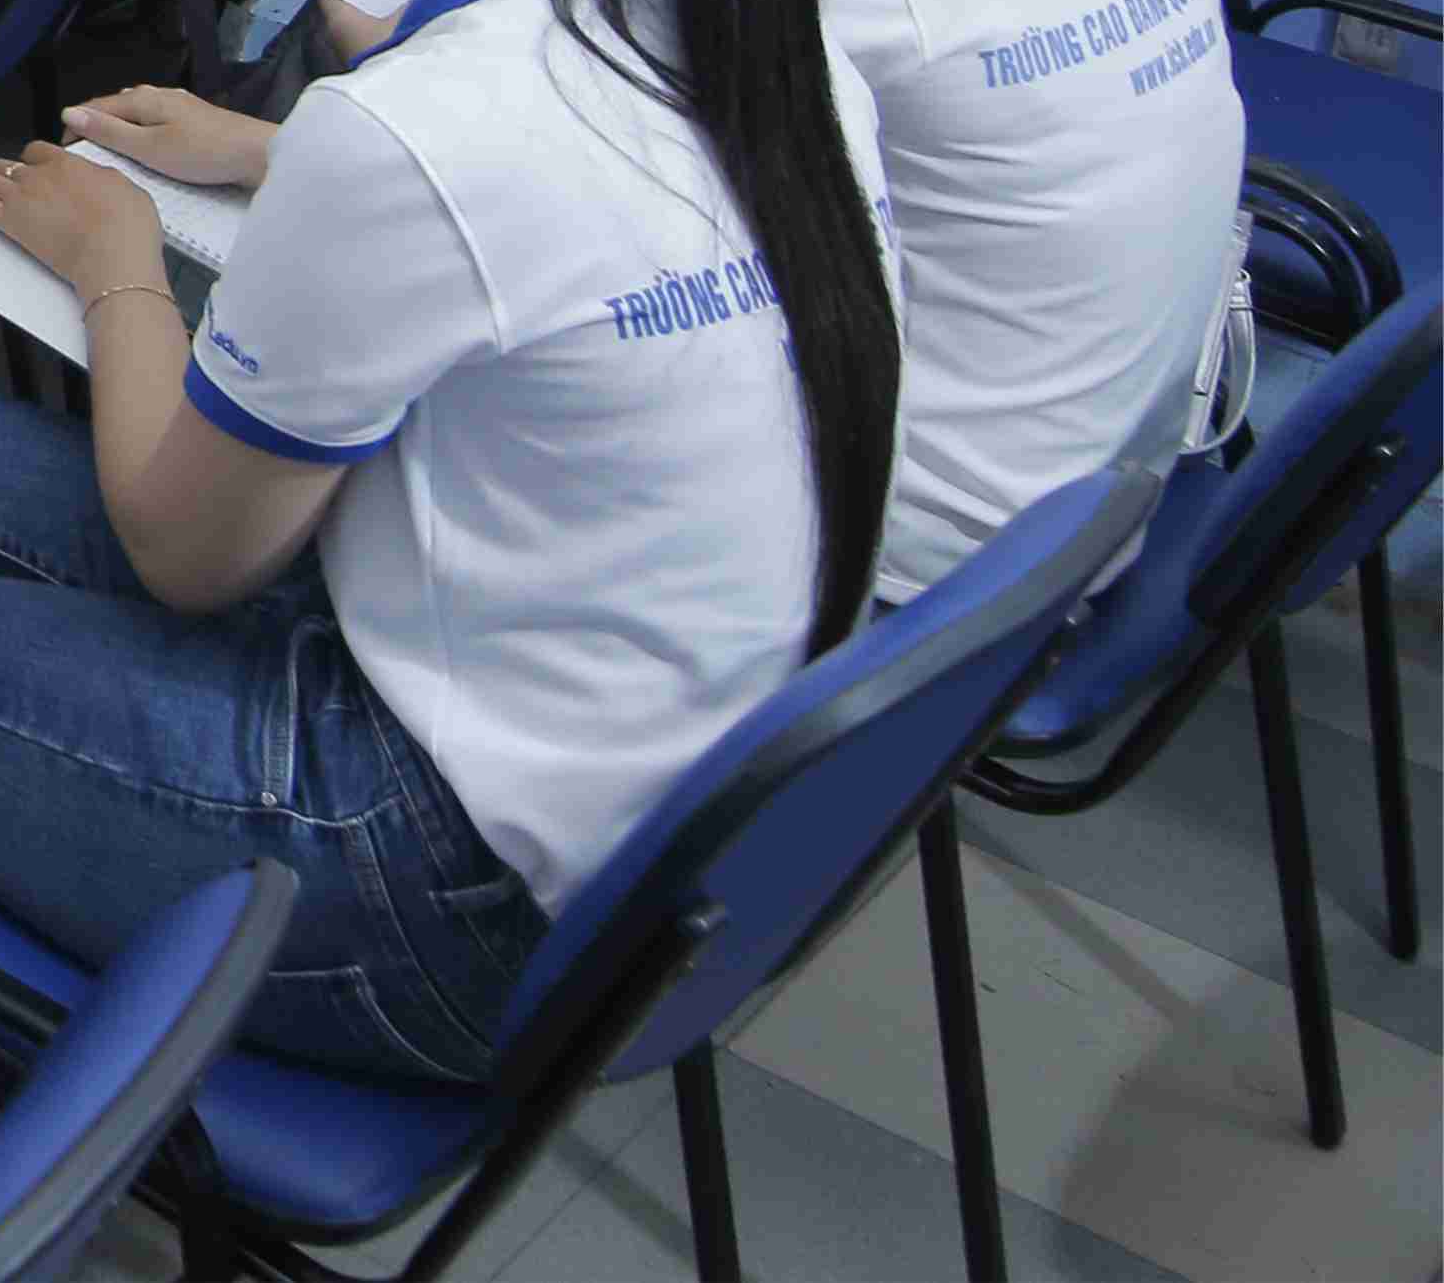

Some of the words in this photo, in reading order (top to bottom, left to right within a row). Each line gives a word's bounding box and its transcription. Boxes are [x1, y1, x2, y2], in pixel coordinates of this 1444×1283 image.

[978, 27, 1087, 89] TRƯỜNG
[1082, 2, 1130, 58] CAO
[603, 268, 733, 340] TRƯỜNG
